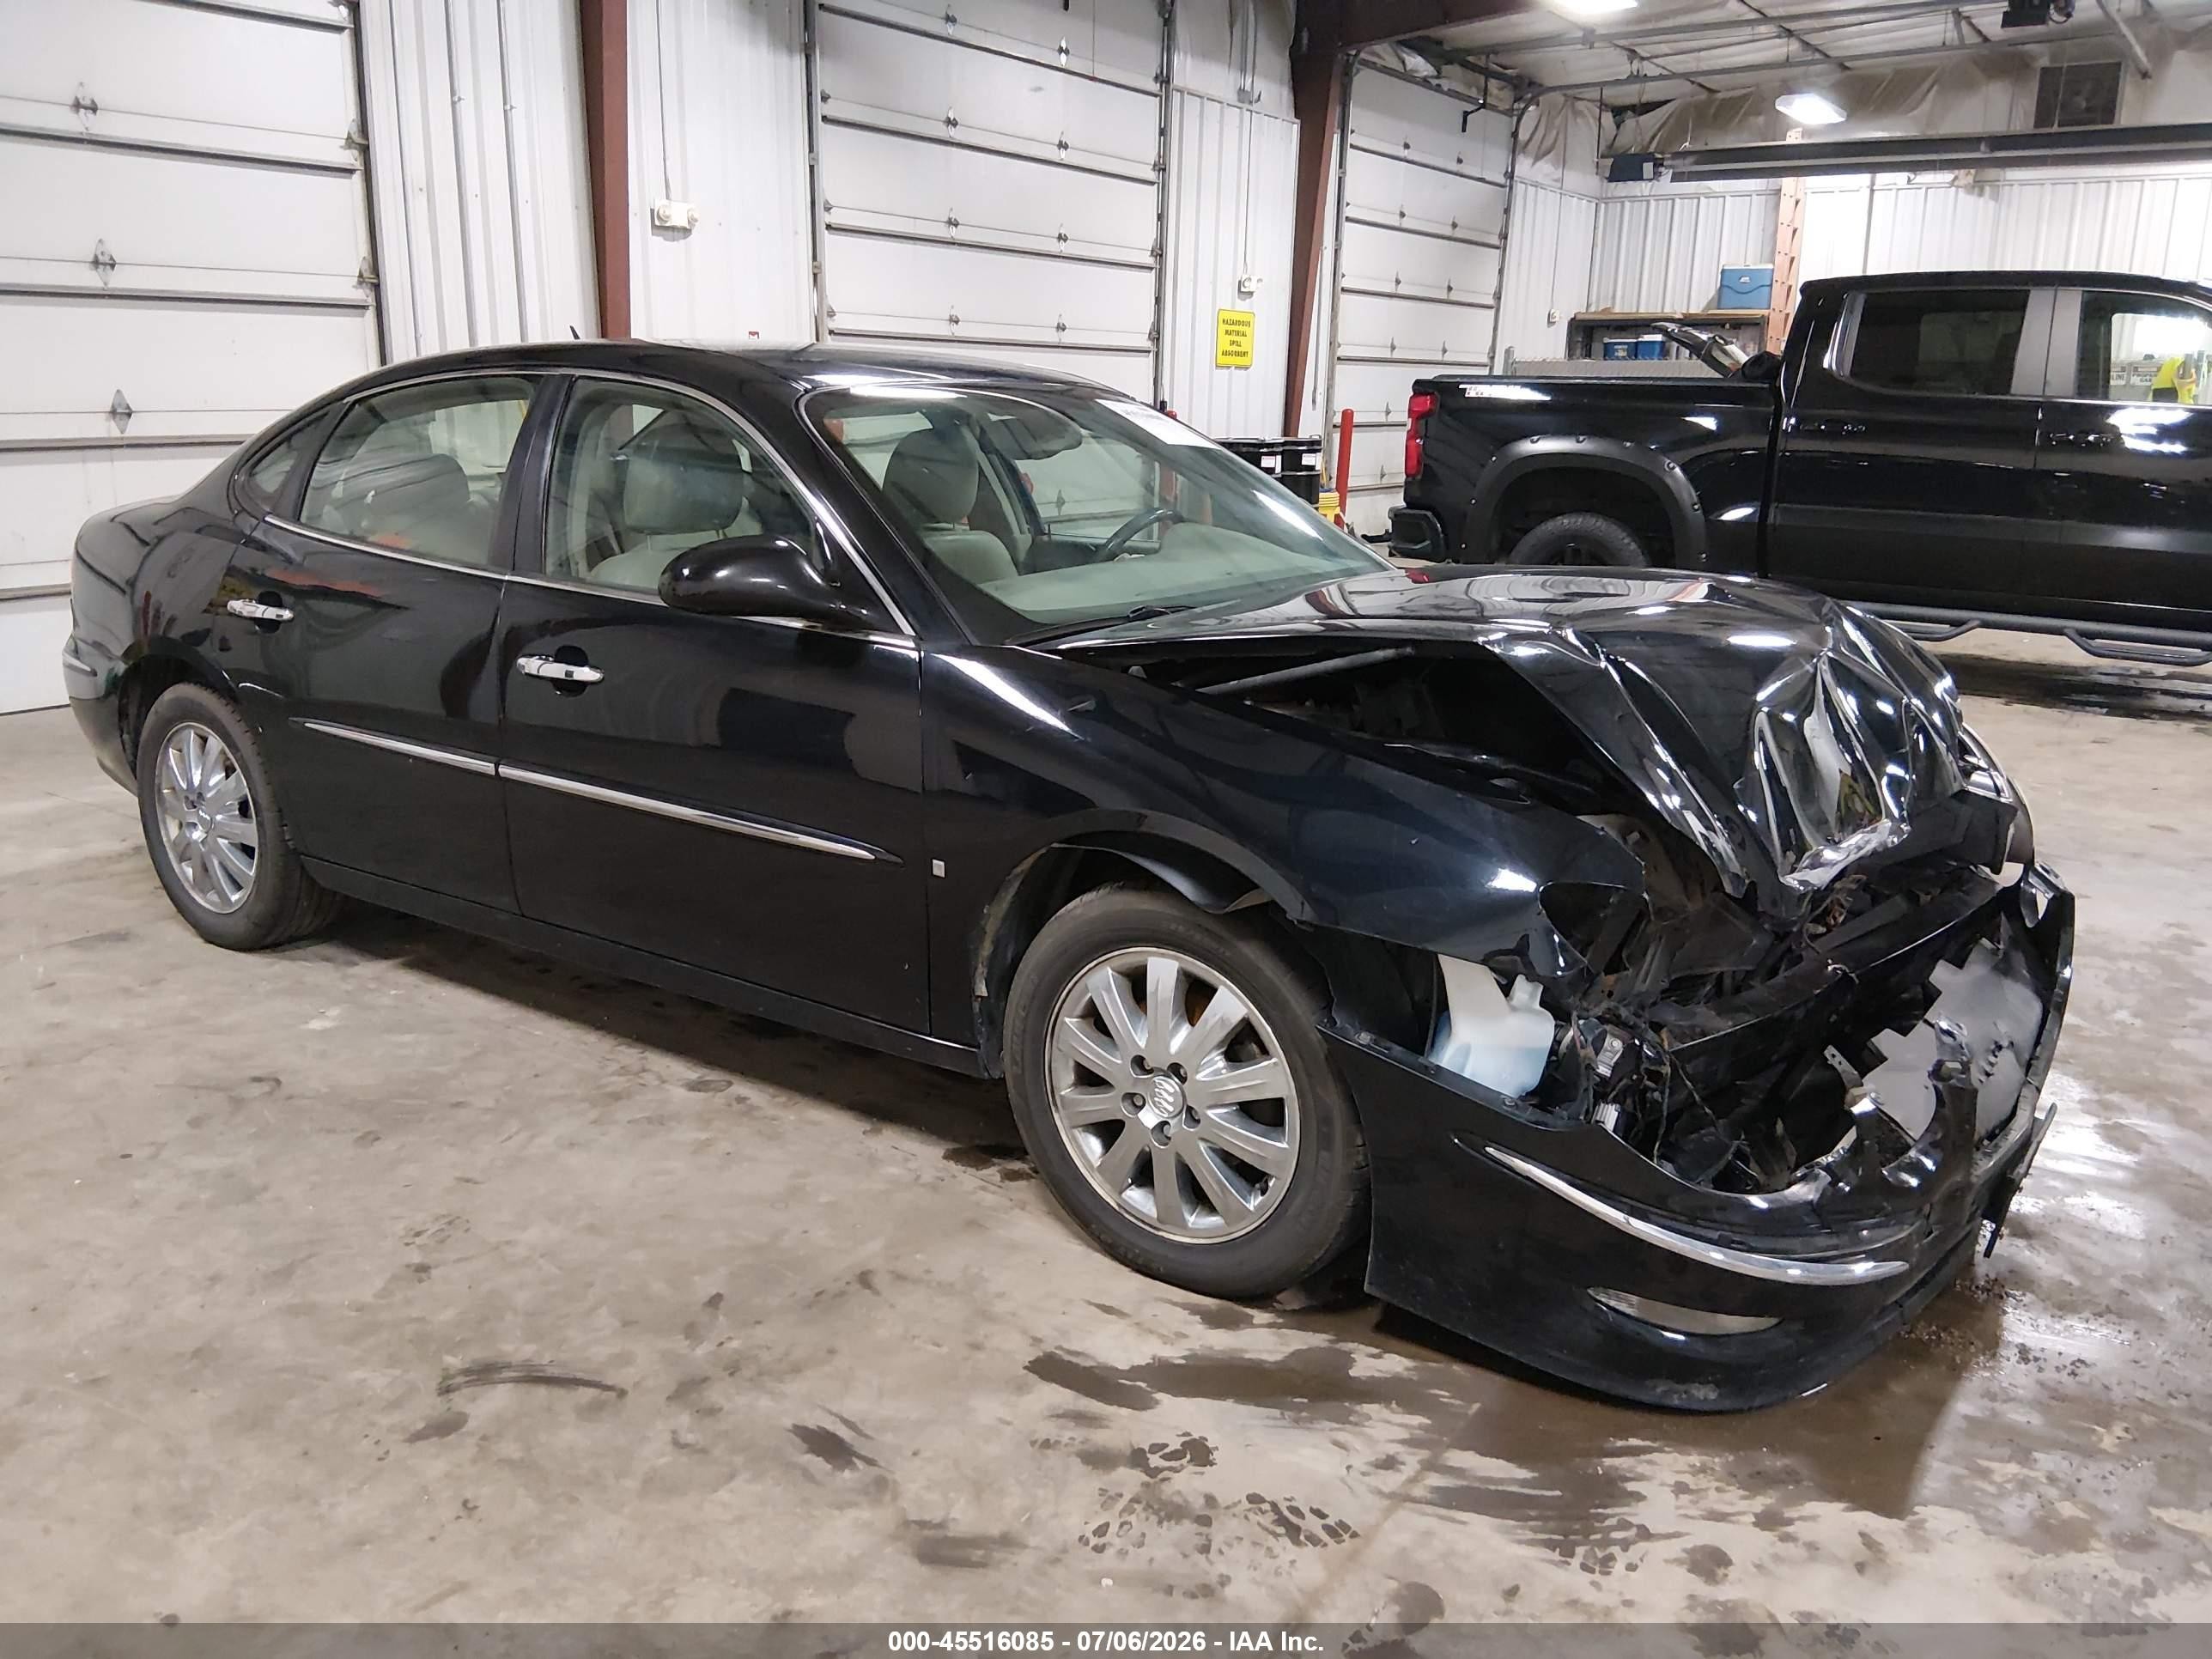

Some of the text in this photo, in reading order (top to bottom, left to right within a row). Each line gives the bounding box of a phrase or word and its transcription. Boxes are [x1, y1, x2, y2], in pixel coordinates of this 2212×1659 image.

[1222, 319, 1251, 328] HAZARDOUS
[1224, 329, 1248, 337] MATERIAL
[1221, 349, 1249, 358] ABSORBENT
[2111, 372, 2124, 380] LINE
